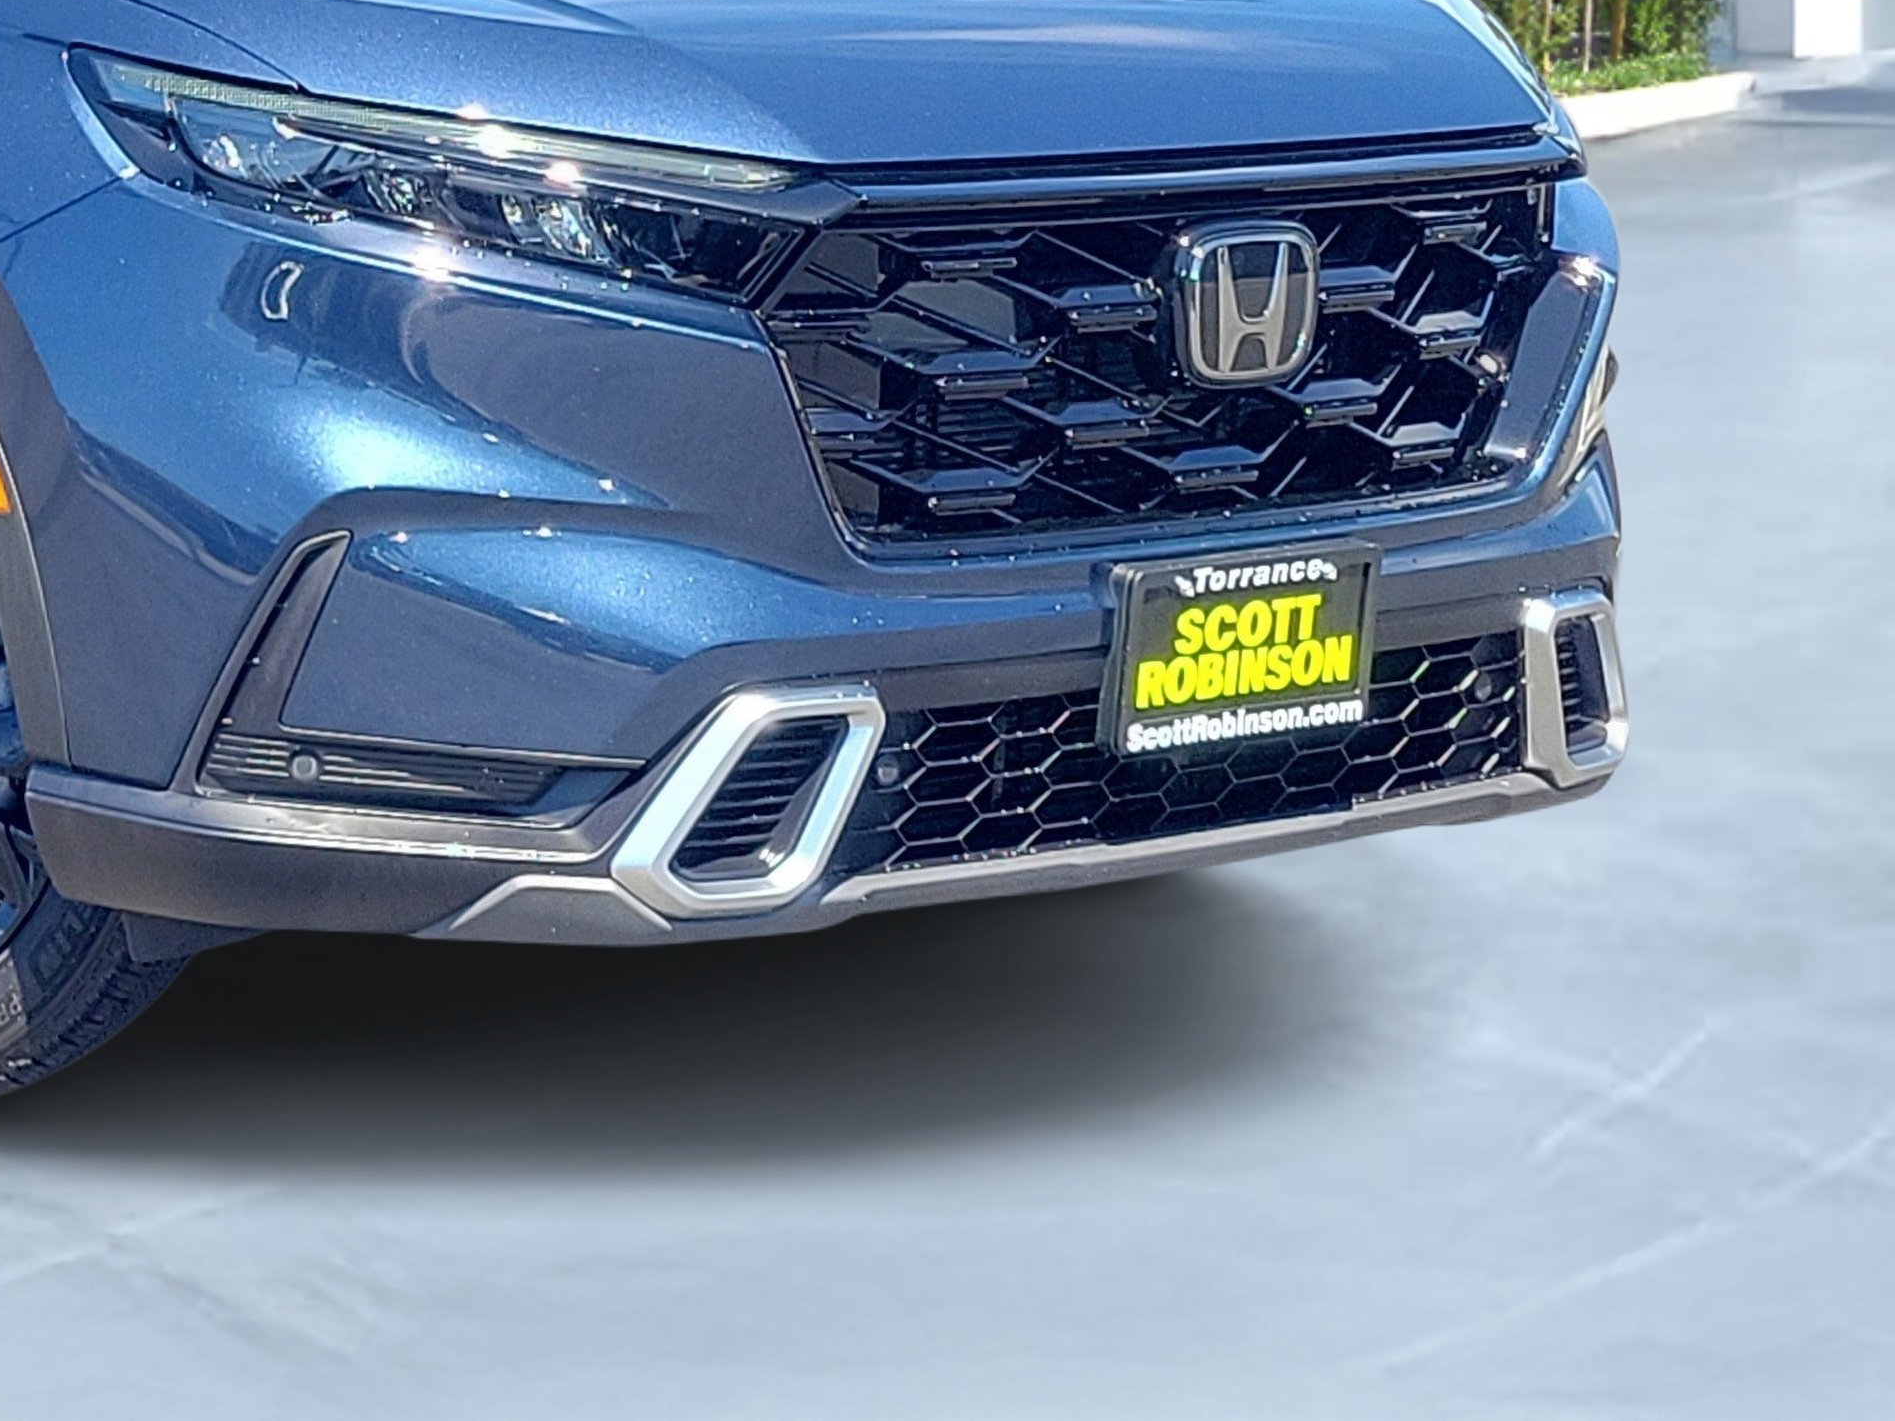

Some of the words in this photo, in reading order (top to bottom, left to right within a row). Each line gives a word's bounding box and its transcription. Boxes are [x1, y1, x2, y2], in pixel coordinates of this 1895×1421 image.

[1193, 558, 1324, 594] Torrance
[1174, 593, 1322, 655] SCOTT
[1135, 635, 1353, 709] ROBINSON
[1126, 699, 1364, 753] ScottRobinson.com
